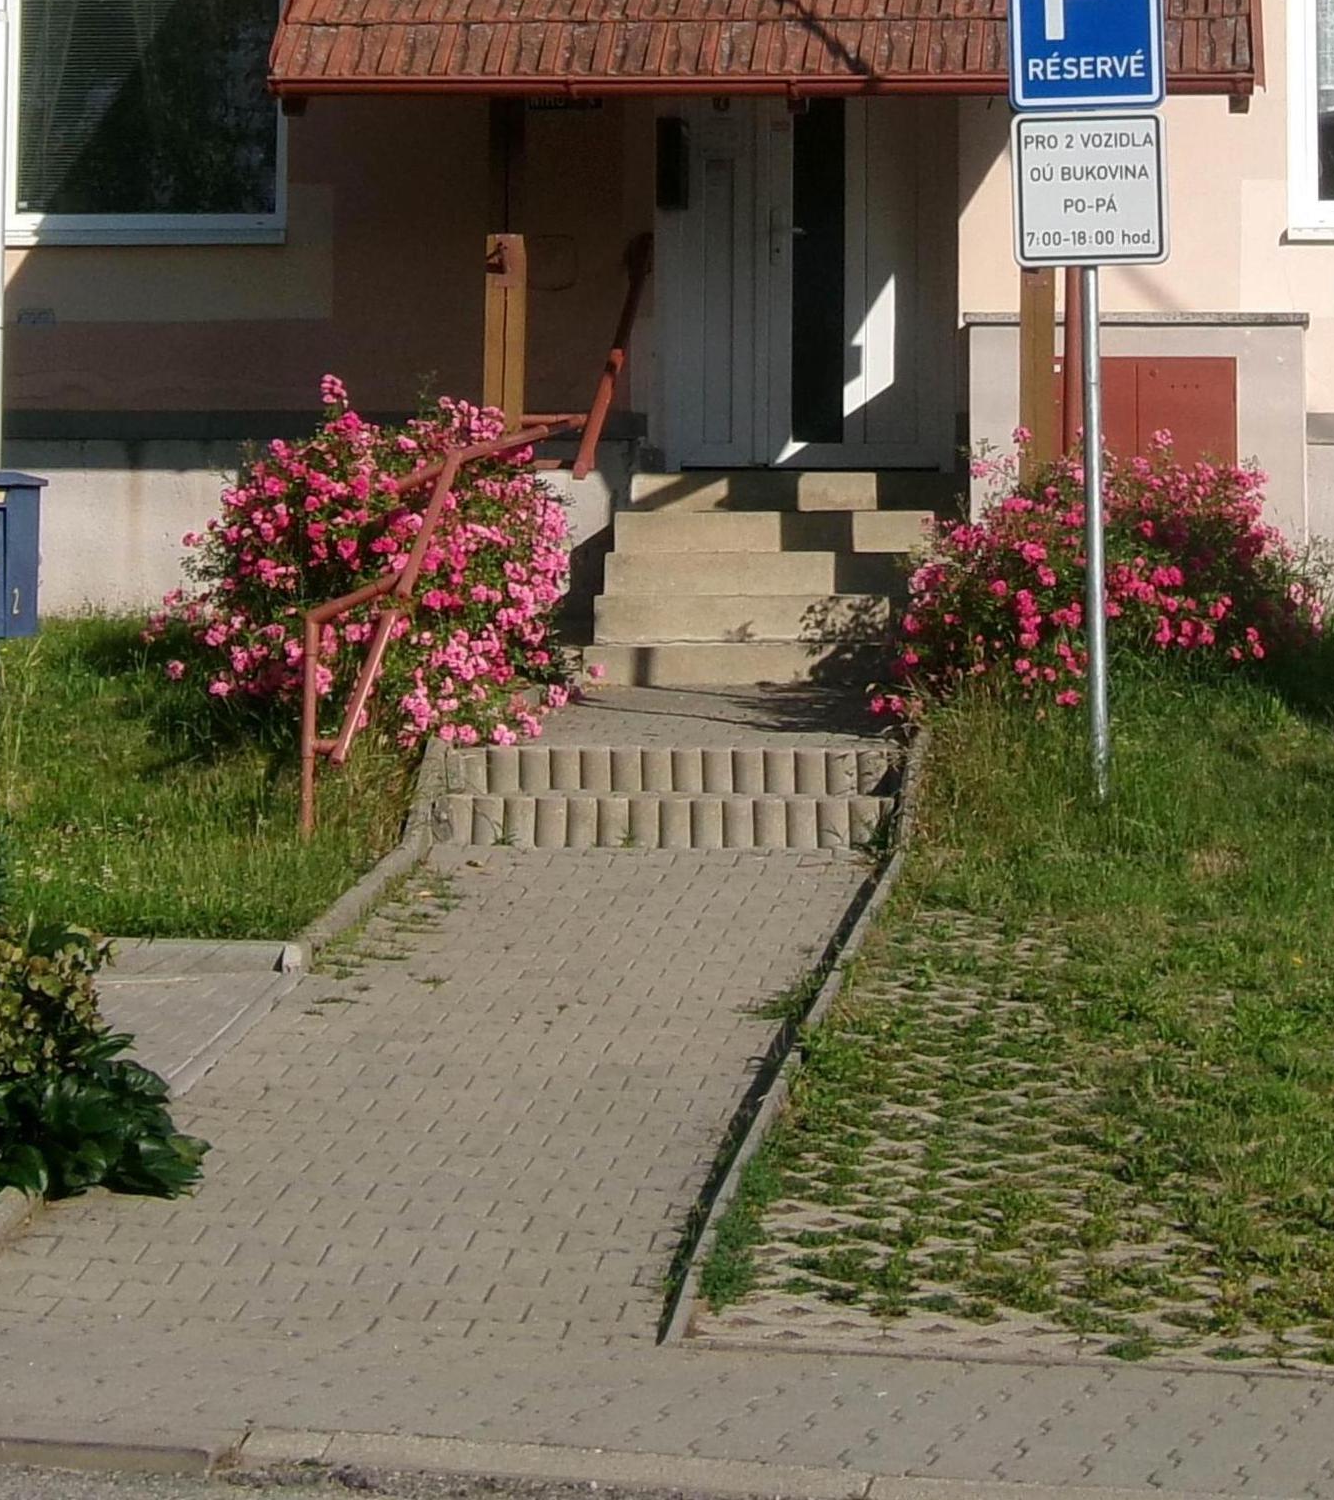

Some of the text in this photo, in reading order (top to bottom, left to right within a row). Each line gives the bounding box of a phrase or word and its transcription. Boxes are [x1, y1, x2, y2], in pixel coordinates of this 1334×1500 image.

[1027, 49, 1146, 81] RÉSERVÉ
[1024, 132, 1154, 150] PRO 2 VOZIDLA
[1029, 163, 1149, 182] OÚ BUKOVINA
[1063, 193, 1118, 213] PO-PÁ
[1026, 228, 1155, 247] 7:00-18:00 hod.
